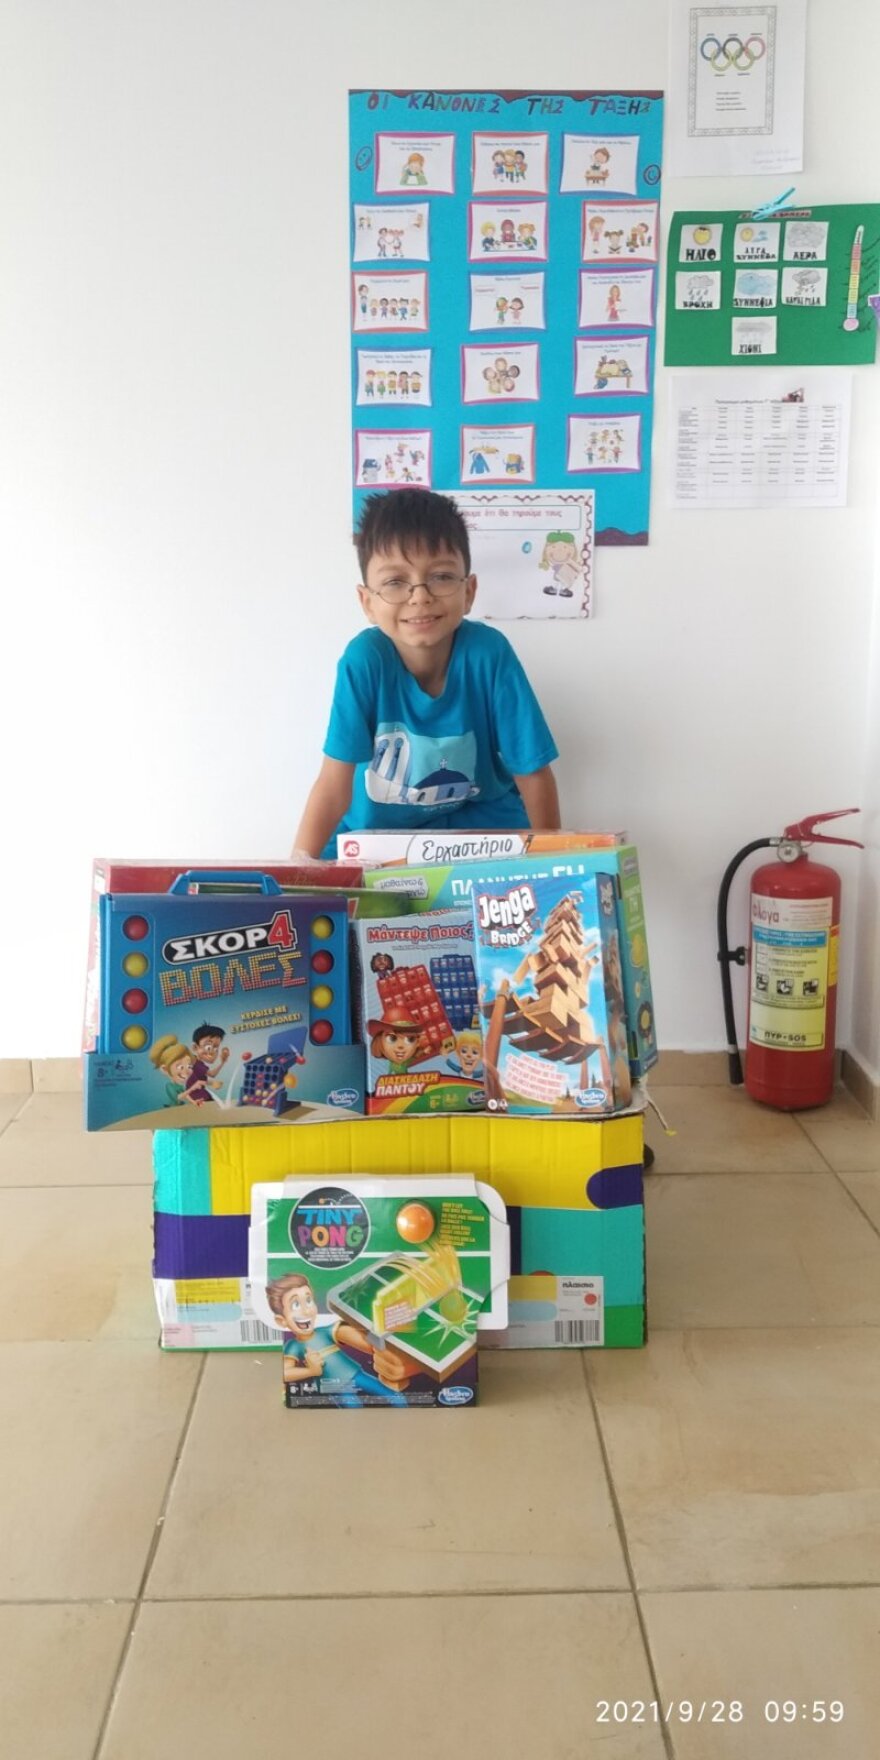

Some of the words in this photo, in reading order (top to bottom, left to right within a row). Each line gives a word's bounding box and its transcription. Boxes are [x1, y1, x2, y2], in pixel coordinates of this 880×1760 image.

[367, 92, 390, 111] ΟΙ
[407, 91, 500, 114] ΚΑΝΟΝΕΣ
[527, 97, 565, 116] ΤΗΣ
[588, 98, 652, 116] ΤΑΞΗΣ
[479, 886, 536, 928] Jenga
[170, 927, 268, 962] ΣΚΟΡ
[267, 912, 295, 949] 4
[366, 923, 428, 944] Μάντεψε
[491, 921, 533, 946] BRIDGE
[158, 951, 308, 1008] ΒΟΛΕΣ
[375, 1083, 426, 1098] ΠΑΝΤΟΥ
[296, 1208, 363, 1226] TINY
[297, 1225, 365, 1248] PONG
